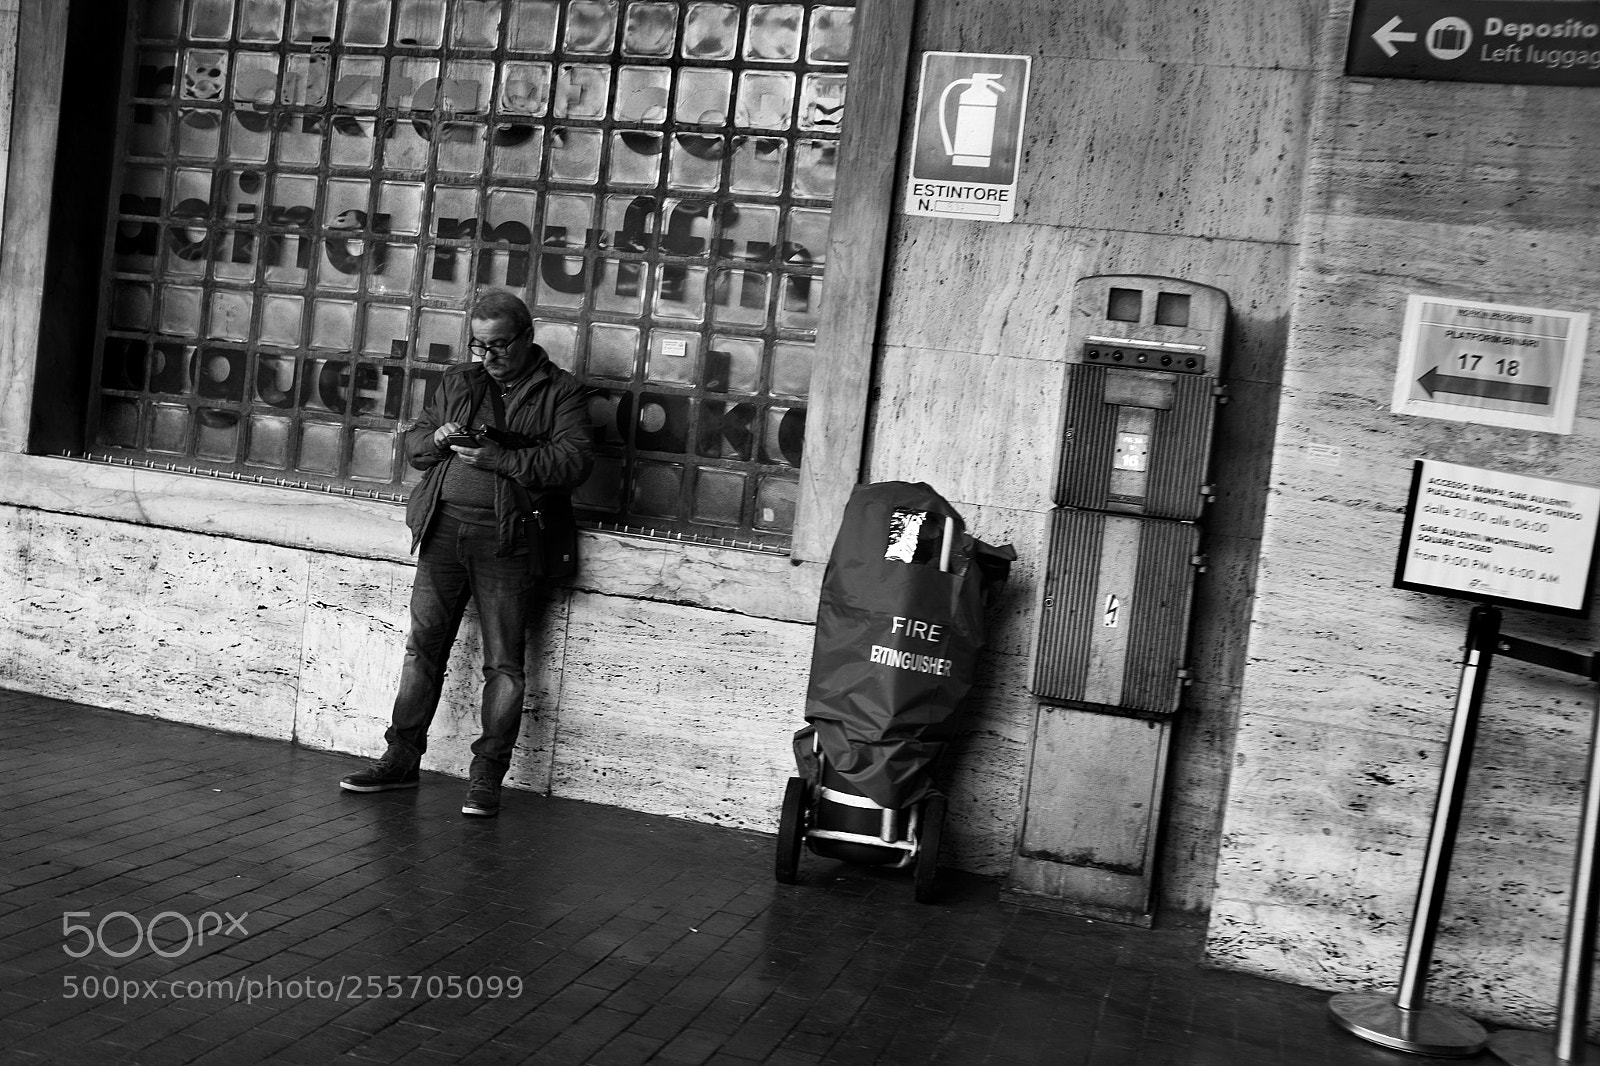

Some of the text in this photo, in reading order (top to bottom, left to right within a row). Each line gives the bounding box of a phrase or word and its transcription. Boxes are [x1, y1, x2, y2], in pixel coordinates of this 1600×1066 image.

[1484, 17, 1600, 42] Deposito
[1480, 44, 1522, 63] Left
[913, 183, 1010, 202] ESTINTORE
[918, 199, 934, 212] N.
[432, 194, 812, 312] muffin
[1458, 353, 1520, 377] 17 18
[1121, 454, 1139, 467] 16
[1426, 487, 1583, 521] PIAZZALE MONTELUNGO CHIUSO
[1428, 478, 1576, 508] ACCESSO RAMPA GAE AULENTI
[1422, 503, 1550, 533] dalle 21:00 alle 06:00
[1416, 533, 1494, 554] SQUARE CLOSED
[1419, 524, 1555, 554] GAE AULENTI MONTELUNGO
[1413, 548, 1560, 584] from 9:00 PM to 6:00 AM
[891, 616, 943, 642] FIRE
[869, 645, 953, 677] EXTINGUISHER
